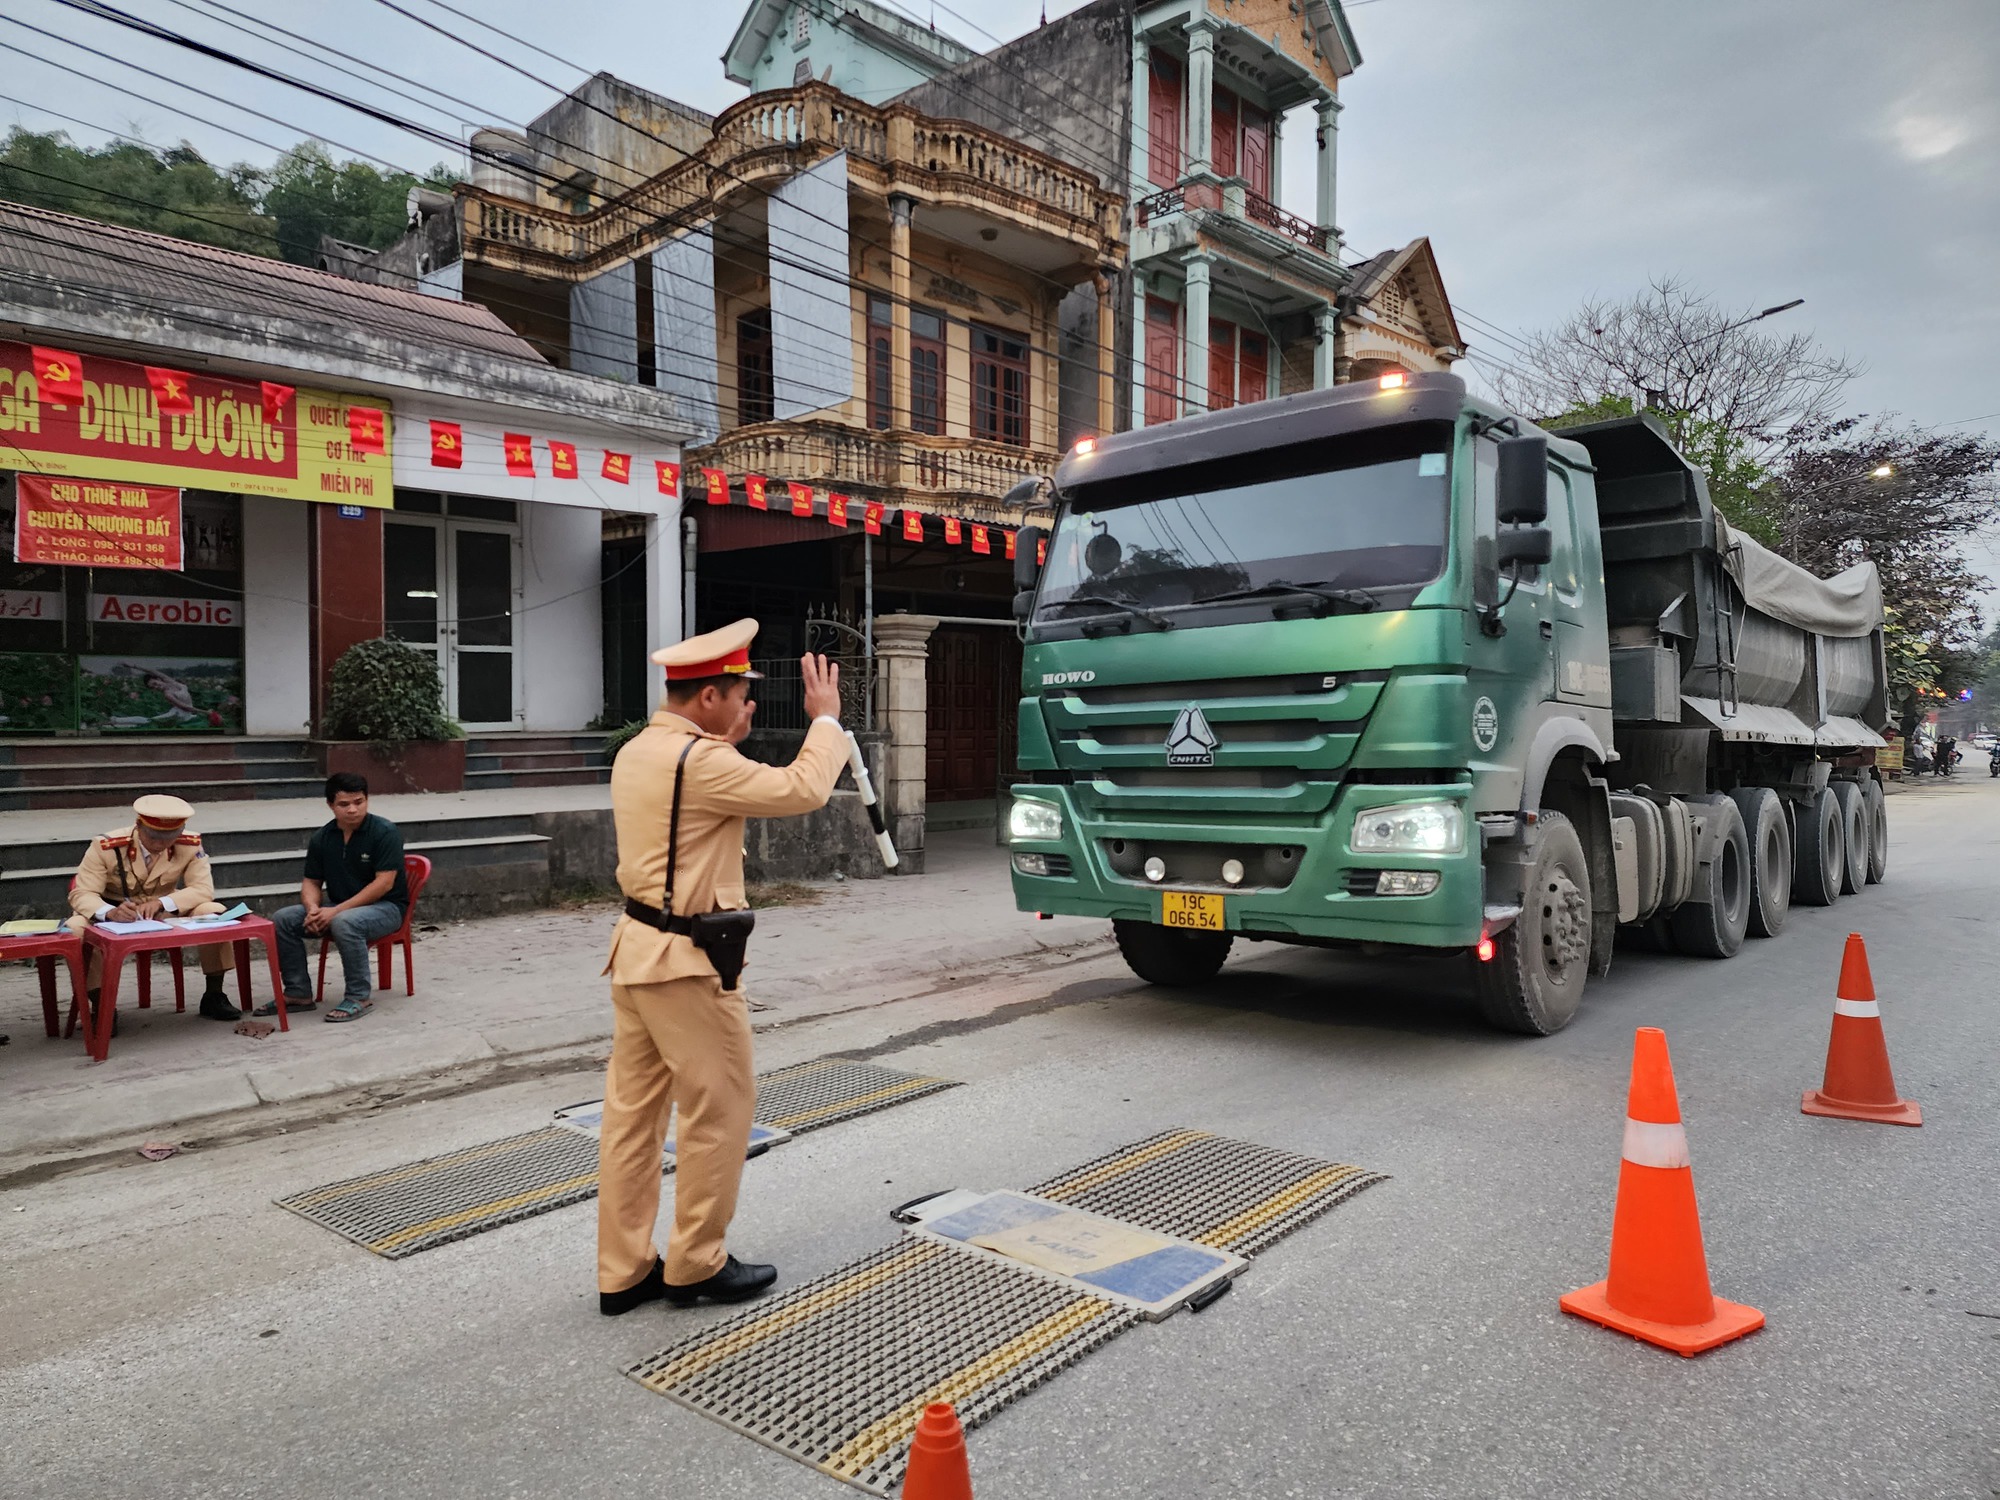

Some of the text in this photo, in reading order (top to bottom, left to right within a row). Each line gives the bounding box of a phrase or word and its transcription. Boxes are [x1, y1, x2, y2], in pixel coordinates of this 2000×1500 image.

[80, 379, 160, 448] DINH
[321, 468, 374, 496] MIỄN PHÍ
[51, 483, 149, 508] CHO THUÊ NHÀ
[27, 507, 171, 537] CHUYỂN NHƯỢNG ĐẤT
[51, 536, 91, 548] LONG:
[123, 541, 142, 551] 931
[100, 596, 232, 624] Aerobic
[1042, 670, 1096, 685] HOWO
[1170, 755, 1211, 763] CNHTC
[1181, 894, 1206, 910] 19C
[1169, 910, 1217, 928] 066.54
